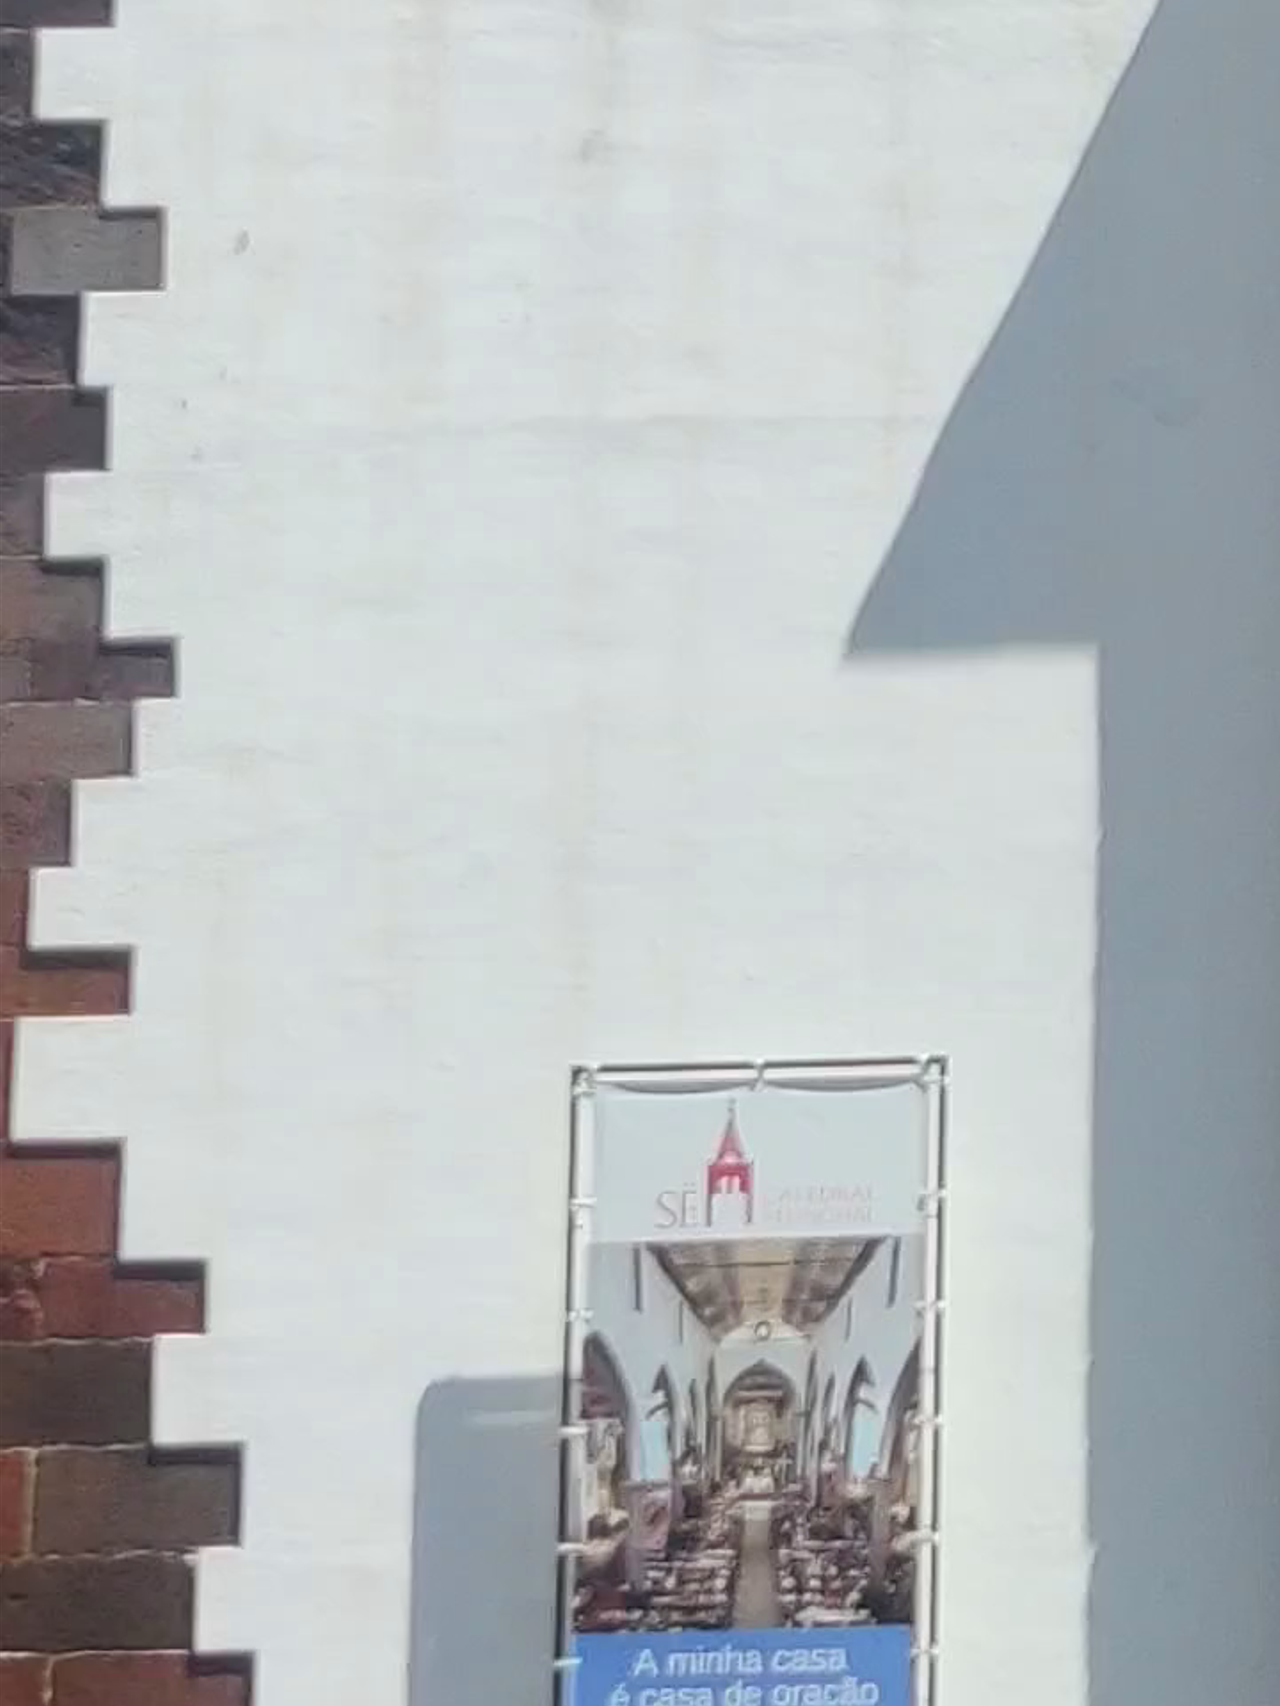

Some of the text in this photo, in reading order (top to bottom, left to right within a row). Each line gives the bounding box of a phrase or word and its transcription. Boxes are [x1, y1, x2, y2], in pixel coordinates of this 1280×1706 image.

[633, 1644, 848, 1676] A minha casa
